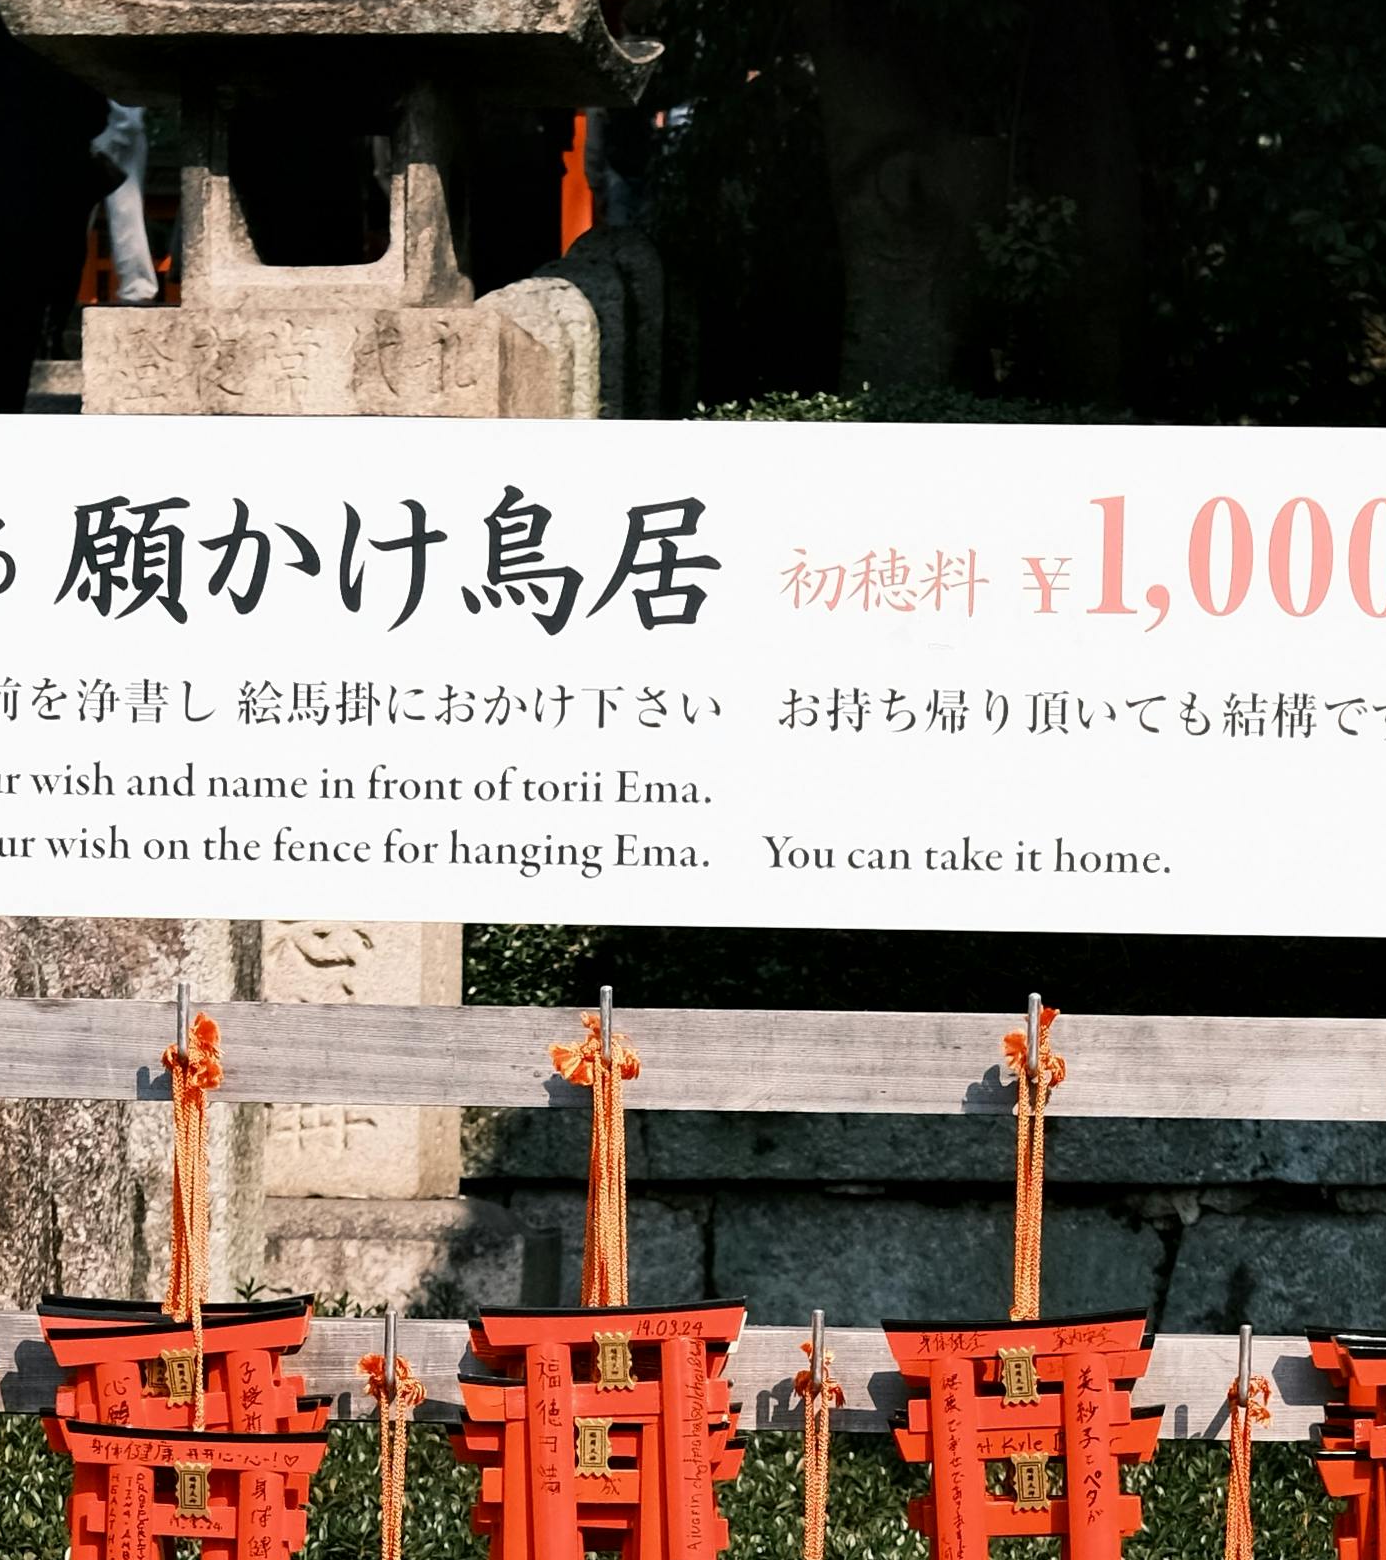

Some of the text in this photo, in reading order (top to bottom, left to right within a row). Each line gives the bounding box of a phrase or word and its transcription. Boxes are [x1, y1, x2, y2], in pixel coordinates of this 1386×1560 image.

[53, 484, 723, 637] 願かけ鳥居
[781, 548, 989, 617] 初穂料
[235, 676, 721, 729] 絵馬掛におかけ下さい
[30, 761, 115, 795] wish
[127, 763, 195, 797] and
[208, 777, 307, 798] name
[320, 768, 355, 798] in
[369, 764, 462, 800] front
[474, 766, 513, 801] of
[522, 769, 602, 802] torii
[616, 771, 711, 803] Ema.
[45, 825, 130, 859] wish
[144, 839, 189, 859] on
[204, 826, 260, 860] the
[274, 827, 370, 862] fence
[384, 828, 438, 863] for
[449, 829, 603, 878] hanging
[614, 834, 709, 867] Ema.
[762, 836, 835, 868] You
[848, 849, 911, 870] can
[925, 836, 1002, 871] take
[1016, 841, 1042, 871] it
[1054, 837, 1170, 873] home.
[91, 1438, 175, 1462] 身体健康
[536, 1355, 563, 1496] 福徳円満
[1001, 1433, 1044, 1453] Kyle
